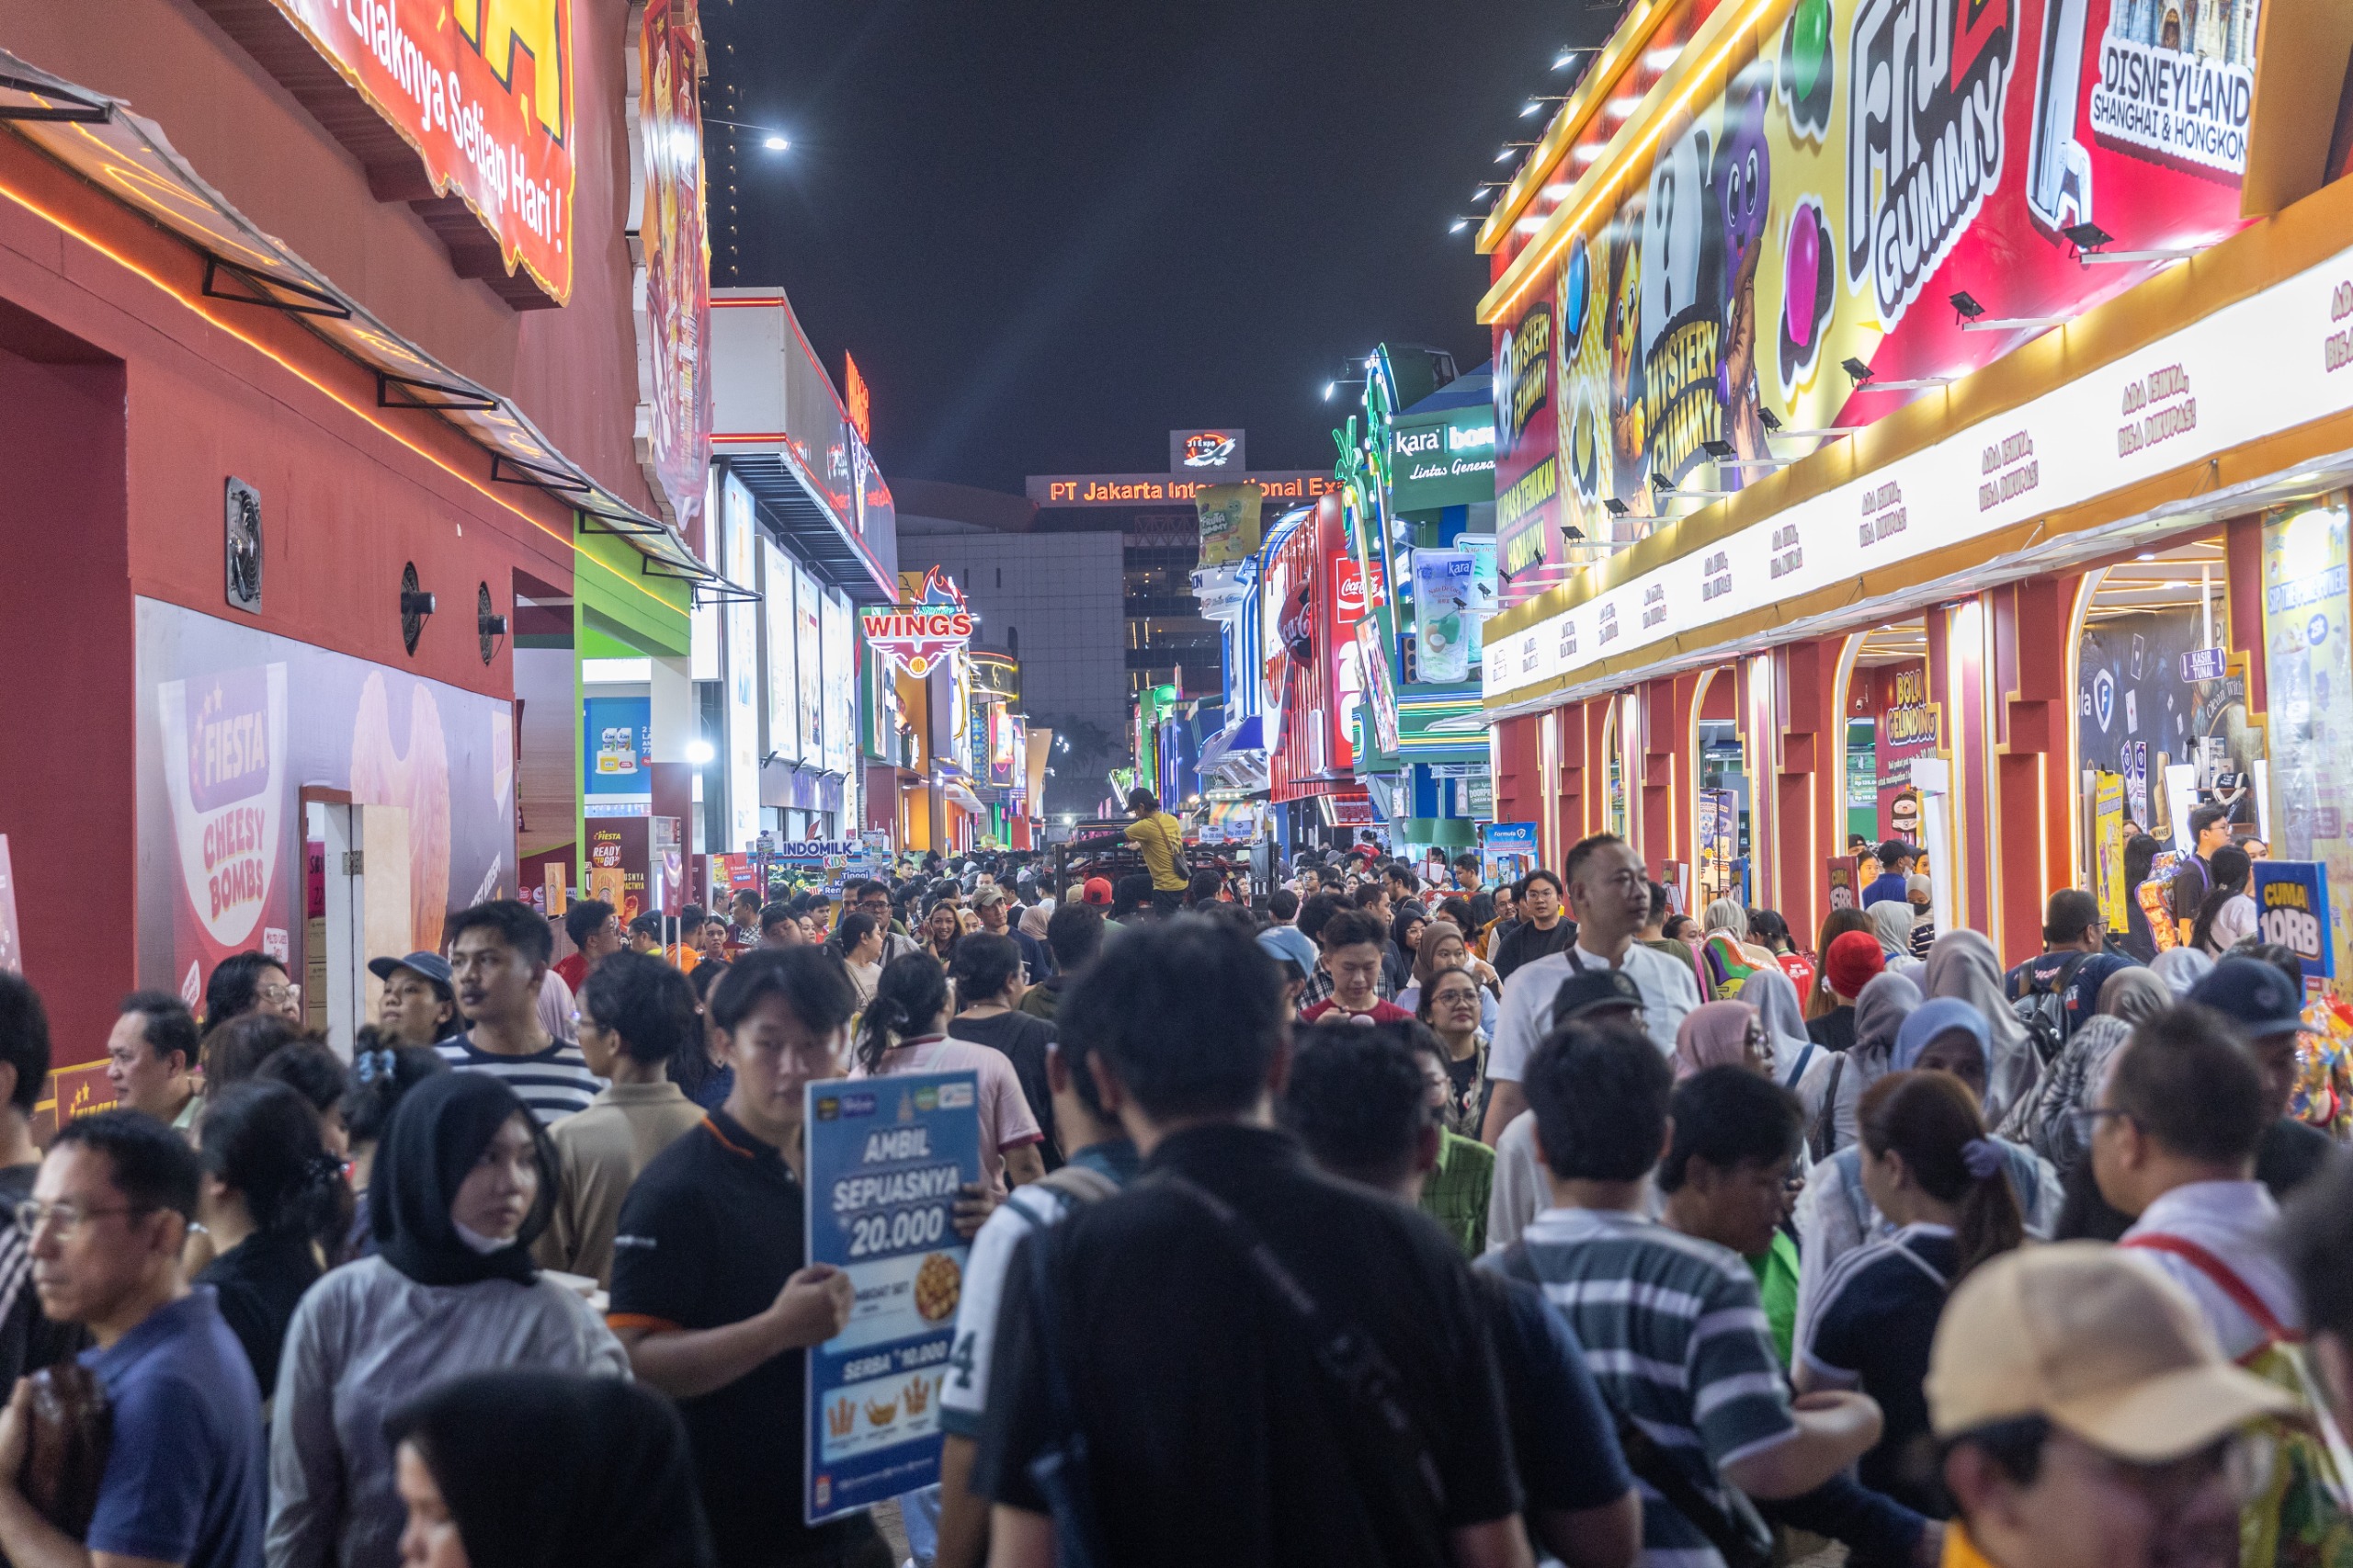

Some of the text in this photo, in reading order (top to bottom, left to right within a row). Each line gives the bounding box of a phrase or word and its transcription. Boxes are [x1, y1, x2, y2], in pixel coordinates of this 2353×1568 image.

[2105, 46, 2250, 128] DISNEYLAND
[2093, 93, 2159, 138] SHANGHAI
[2162, 112, 2171, 142] &
[449, 71, 507, 215] Setiap
[511, 143, 551, 244] Hari
[1880, 55, 2000, 305] GUMMY
[2331, 279, 2353, 323] AD
[1512, 313, 1550, 394] MYSTERY
[1645, 320, 1719, 438] MYSTERY
[2122, 362, 2189, 416] ADA ISINYA,
[1514, 358, 1546, 439] GUMMY
[1396, 430, 1439, 457] kara
[1653, 388, 1713, 482] GUMMY
[2118, 396, 2197, 458] BISA DIKUPAS!
[1051, 477, 1345, 501] PT Jakarta Intonal Ex
[1410, 463, 1448, 480] Lintas
[1341, 574, 1381, 597] Coca-Cla
[1449, 561, 1470, 575] kara
[863, 614, 973, 638] WINGS
[2191, 650, 2212, 664] KASIR
[2192, 665, 2213, 679] TUNAI
[1896, 673, 1923, 706] BOLA
[2206, 689, 2226, 719] Clean
[204, 713, 266, 788] FIESTA
[203, 807, 266, 873] CHEESY
[597, 831, 621, 840] FIESTA
[783, 842, 853, 856] INDOMILK
[2152, 827, 2169, 839] WINNER
[592, 846, 621, 858] READY
[603, 856, 615, 867] GO
[210, 858, 264, 924] BOMBS
[623, 872, 644, 882] USNYA
[2263, 882, 2308, 910] CUMA
[2259, 907, 2320, 957] 10RB
[862, 1127, 932, 1164] AMBIL
[832, 1165, 961, 1212] SEPUASNYA
[848, 1205, 945, 1258] 20.000
[843, 1355, 892, 1381] SERBA
